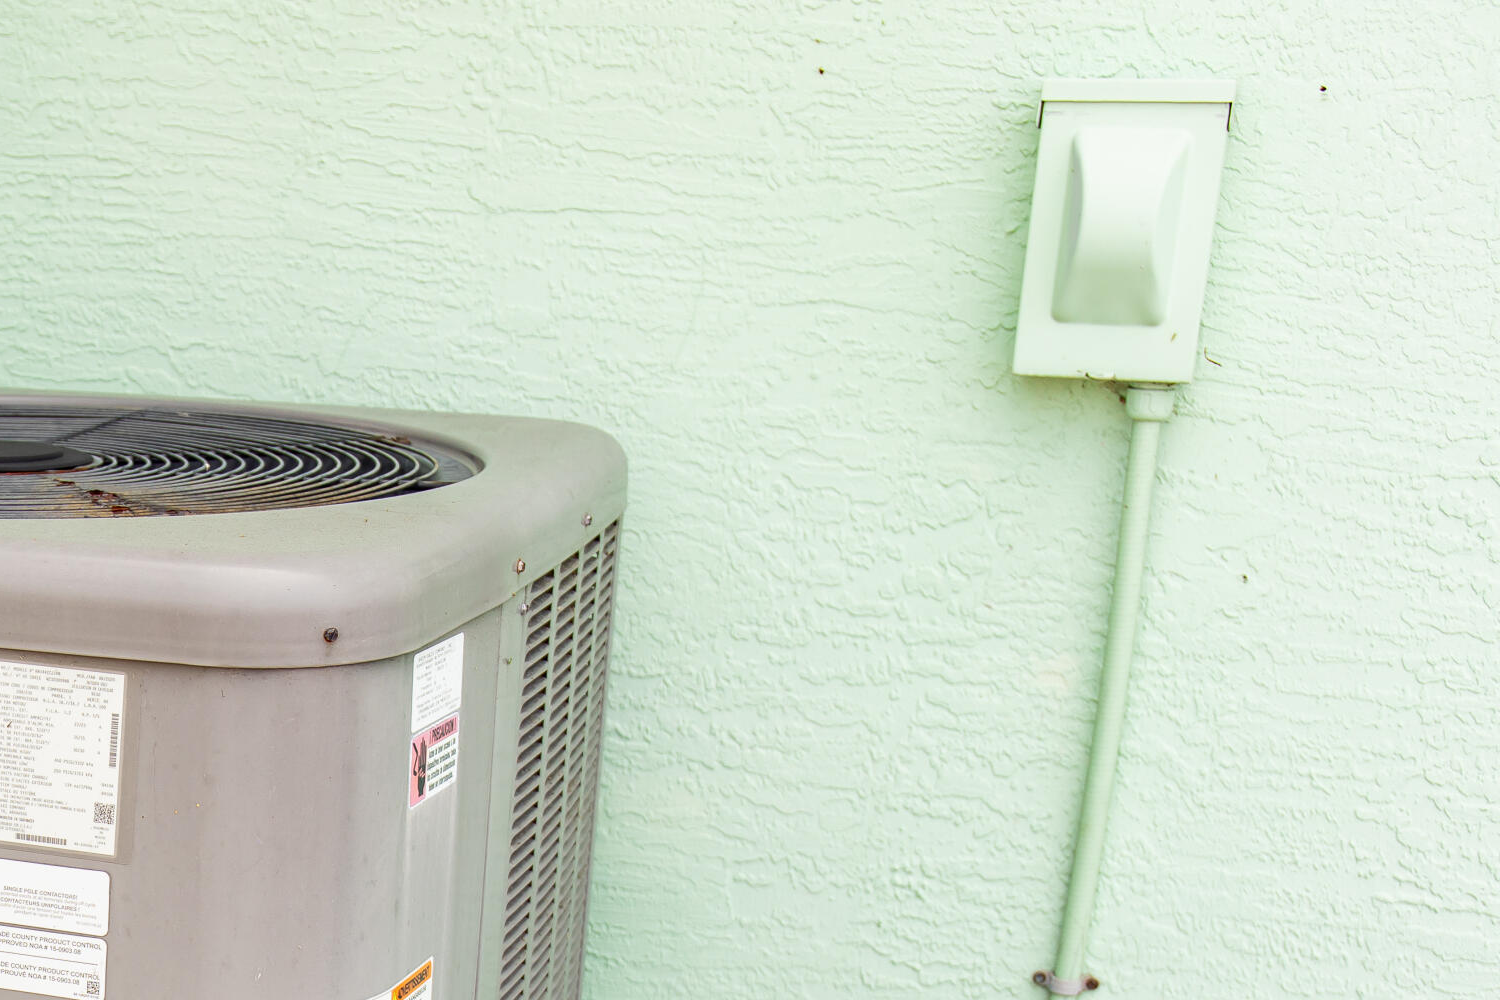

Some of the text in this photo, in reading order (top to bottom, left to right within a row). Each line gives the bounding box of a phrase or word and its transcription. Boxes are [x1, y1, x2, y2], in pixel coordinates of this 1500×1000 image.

[3, 885, 22, 893] SINGLE
[0, 897, 40, 907] CONTACTEURS
[12, 931, 38, 942] COUNTY
[40, 936, 70, 945] PRODUCT
[72, 941, 101, 950] CONTROL
[11, 962, 37, 971] COUNTY
[39, 966, 69, 976] PRODUCT
[71, 971, 100, 980] CONTROL
